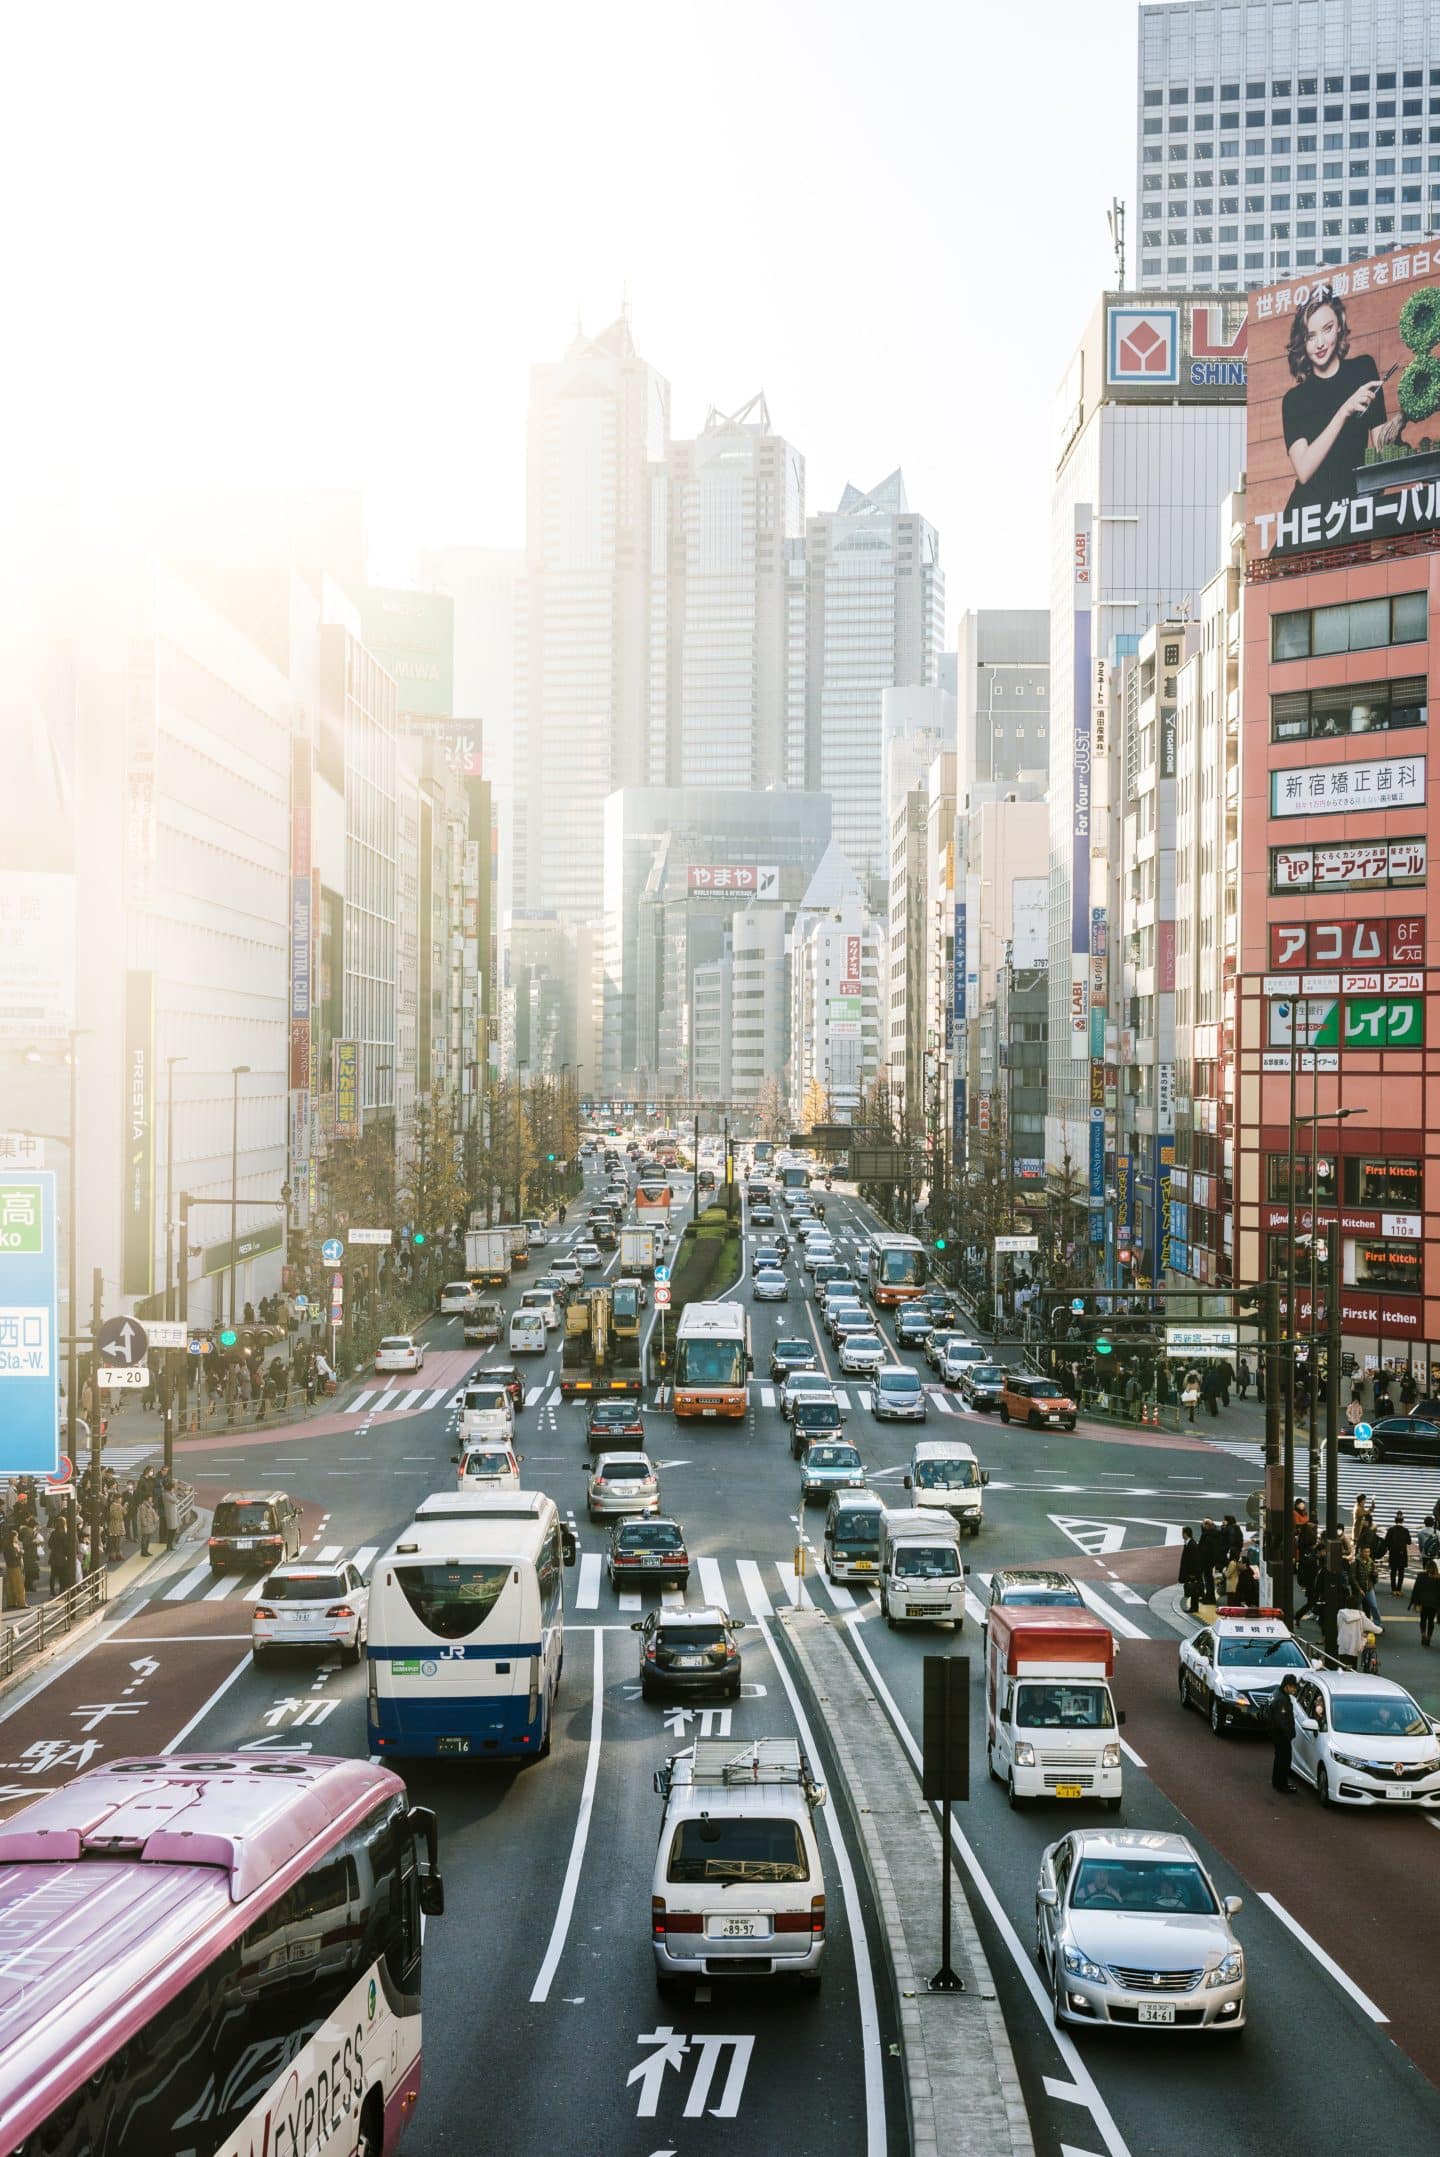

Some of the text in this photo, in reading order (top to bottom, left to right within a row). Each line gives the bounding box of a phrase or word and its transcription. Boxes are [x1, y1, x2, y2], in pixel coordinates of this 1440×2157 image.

[1190, 361, 1248, 386] SHIN
[1075, 532, 1086, 567] LABI
[1285, 764, 1417, 799] 新宿矯正歯科
[1075, 814, 1089, 837] For
[692, 867, 753, 887] やまや
[1314, 855, 1424, 881] エーアイアール
[1092, 907, 1107, 920] 6F
[1397, 923, 1419, 941] 6F
[1278, 923, 1382, 964] アコム
[294, 943, 308, 979] TOTAL
[1405, 951, 1422, 961] 入口
[1346, 977, 1378, 990] アコム
[1387, 976, 1420, 989] アコム
[294, 981, 308, 1012] CLUB
[1072, 982, 1083, 1016] LABI
[1345, 1005, 1414, 1037] レイク
[1092, 1066, 1104, 1100] トレカ
[1389, 1165, 1423, 1177] Kitch
[2, 1191, 35, 1227] 高
[1342, 1217, 1376, 1230] Kitchen
[1389, 1252, 1423, 1265] Kitch
[1343, 1308, 1368, 1320] First
[1368, 1308, 1417, 1324] Kitchen
[1234, 1625, 1276, 1634] 警視庁
[440, 1645, 465, 1660] JR
[663, 1706, 733, 1737] 初
[458, 1741, 469, 1752] 16
[728, 1924, 754, 1936] 89-97
[1146, 2010, 1172, 2021] 34-61
[625, 2025, 756, 2118] 初
[274, 2023, 364, 2157] EXPRESS
